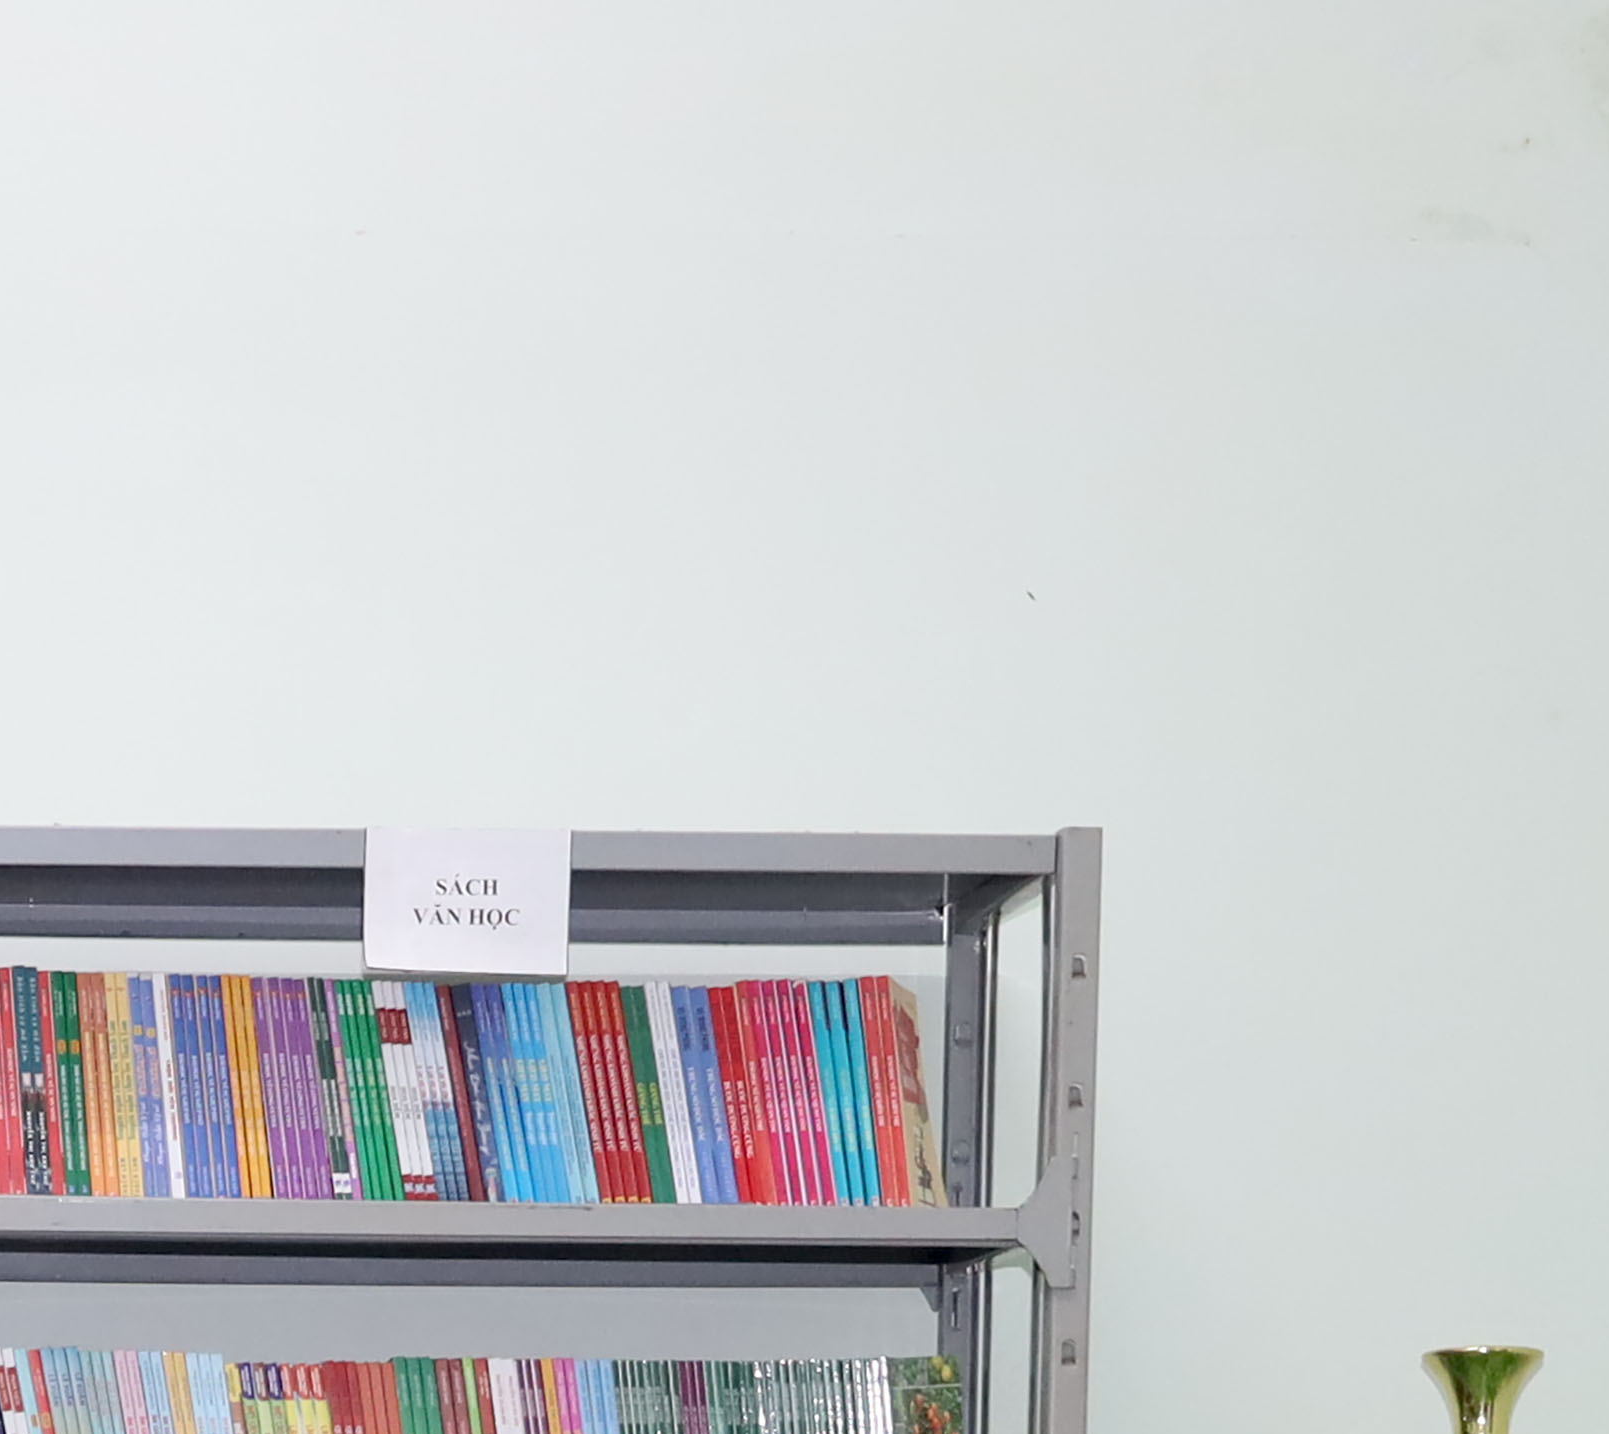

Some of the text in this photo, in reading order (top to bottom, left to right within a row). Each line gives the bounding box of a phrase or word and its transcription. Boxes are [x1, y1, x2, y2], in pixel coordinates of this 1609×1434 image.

[435, 873, 498, 896] SÁCH
[413, 904, 521, 930] VĂN HỌC
